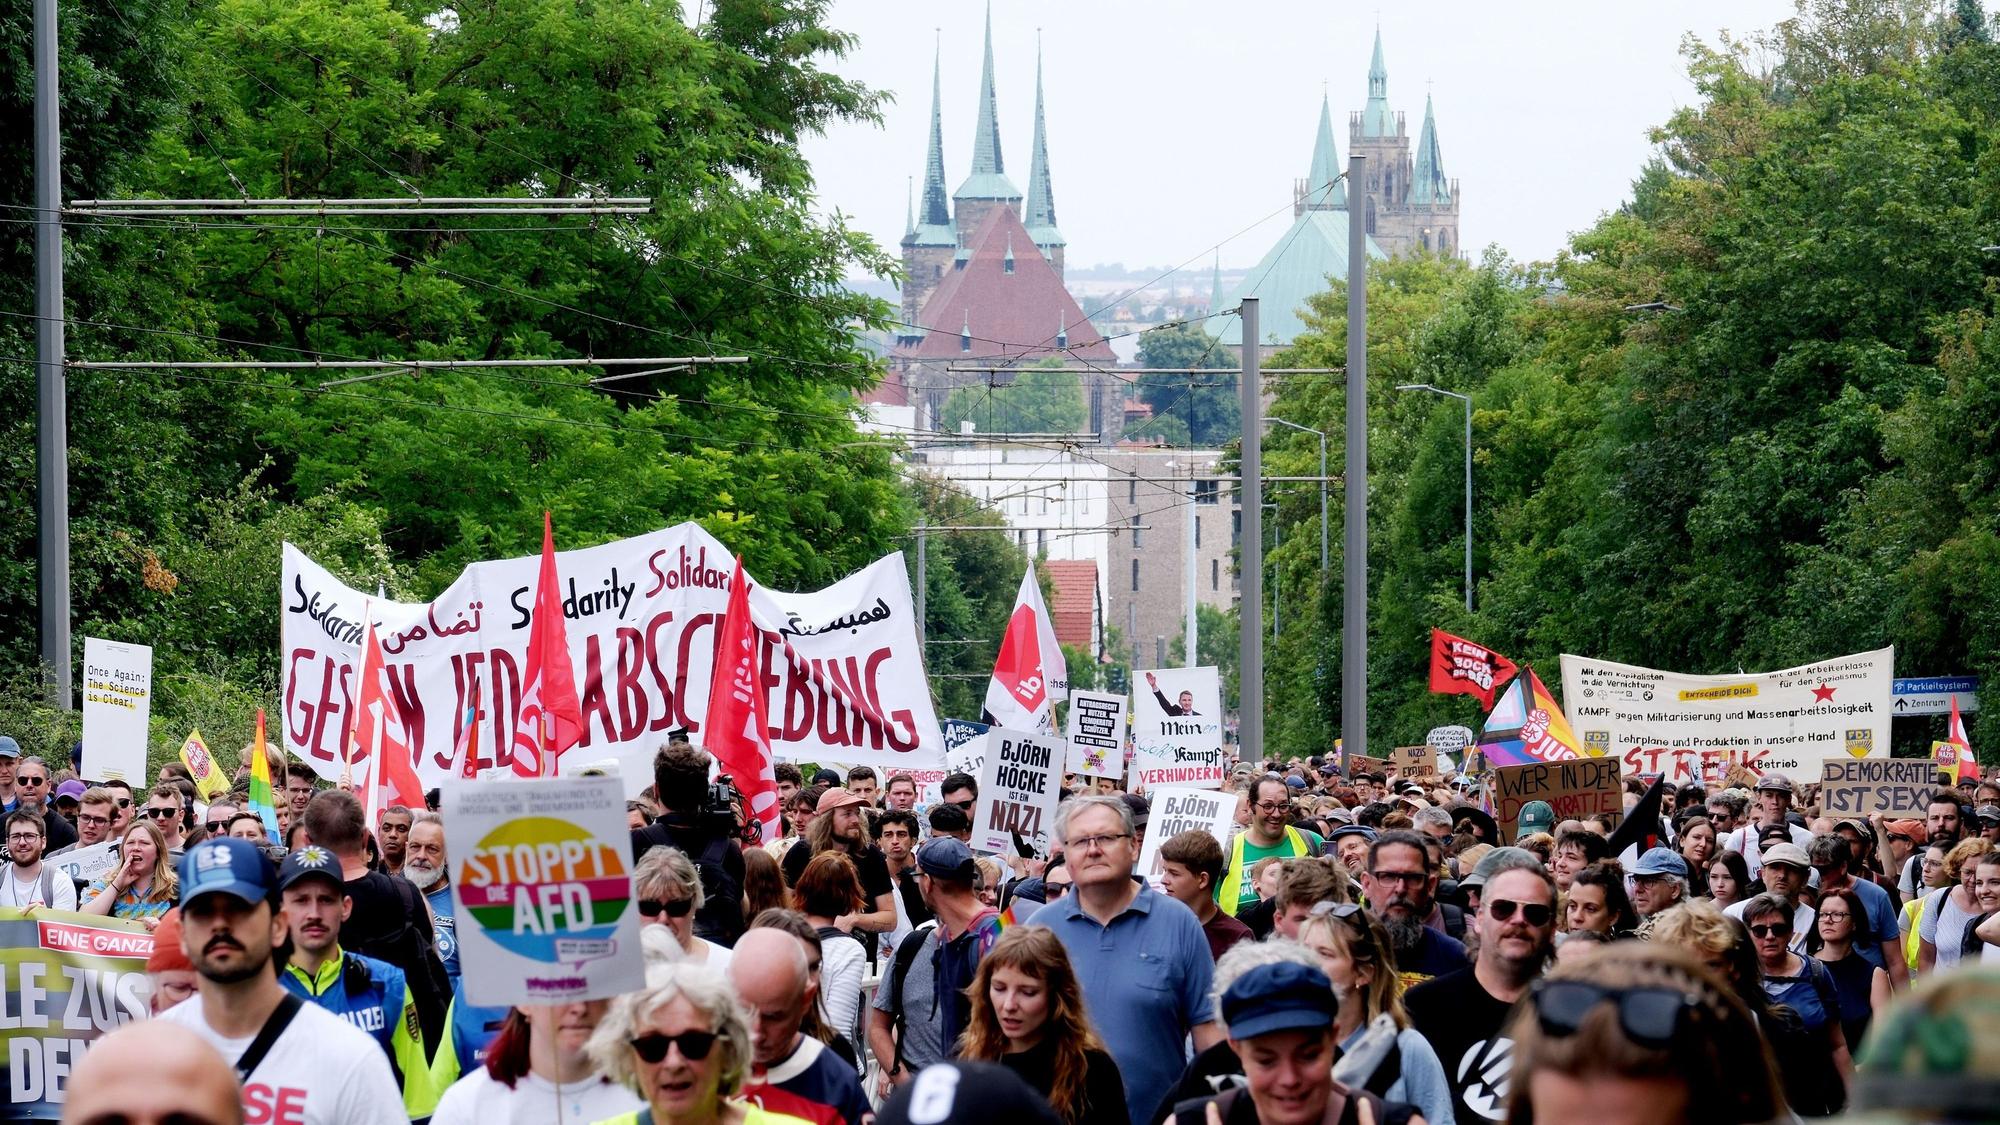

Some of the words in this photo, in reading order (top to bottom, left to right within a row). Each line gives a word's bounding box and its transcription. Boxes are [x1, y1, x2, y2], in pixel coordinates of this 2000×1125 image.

[510, 567, 636, 630] Sdarity
[1452, 641, 1488, 662] KEIN
[88, 665, 109, 678] Once
[114, 669, 146, 683] Again:
[1453, 656, 1492, 675] BOCK
[1581, 668, 1594, 676] Mit
[1597, 669, 1613, 677] den
[1806, 661, 1873, 675] Arbeiterklasse
[88, 679, 103, 690] The
[108, 681, 146, 697] Science
[1591, 679, 1603, 687] die
[1606, 680, 1655, 690] Vernichtung
[1779, 680, 1793, 688] für
[1797, 678, 1813, 686] den
[1816, 672, 1868, 684] Sozialismus
[1907, 681, 1971, 692] Parkleitsystem
[88, 692, 98, 702] is
[103, 694, 134, 708] Clear!
[1685, 688, 1732, 698] ENTSCHEIDE
[1733, 687, 1752, 695] DICH
[433, 647, 528, 770] JED
[1079, 699, 1118, 711] ANTRAGSRECHT
[1578, 706, 1611, 717] KAMPF
[1615, 712, 1643, 722] gegen
[1647, 711, 1721, 723] Militarisierung
[1725, 711, 1744, 720] und
[1747, 702, 1874, 720] Massenarbeitslosigkeit
[1911, 699, 1946, 708] Zentrum
[1081, 716, 1114, 728] DEMOKRATIE
[1672, 737, 1690, 747] und
[1693, 735, 1750, 747] Produktion
[1753, 735, 1763, 745] in
[1766, 735, 1804, 745] unsere
[1808, 730, 1836, 742] Hand
[1000, 739, 1052, 769] BJÖRN
[1174, 747, 1222, 767] Kampf
[1408, 748, 1427, 758] NAZIS
[1757, 759, 1798, 769] Betrieb
[1824, 761, 1939, 785] DEMOKRATIE
[996, 762, 1048, 794] HÖCKE
[1139, 766, 1222, 785] VERHINDERN
[1498, 765, 1549, 797] WER
[1561, 764, 1577, 789] IN
[1581, 759, 1620, 788] DER
[1008, 791, 1019, 801] IST
[1019, 792, 1030, 802] EIN
[1826, 786, 1871, 813] IST
[1875, 786, 1937, 812] SEXY
[1164, 793, 1220, 819] BJÖRN
[988, 799, 1042, 838] NAZI
[466, 837, 611, 888] STOPPT
[486, 884, 510, 902] DIE
[513, 883, 595, 936] AFD
[46, 928, 91, 949] EINE
